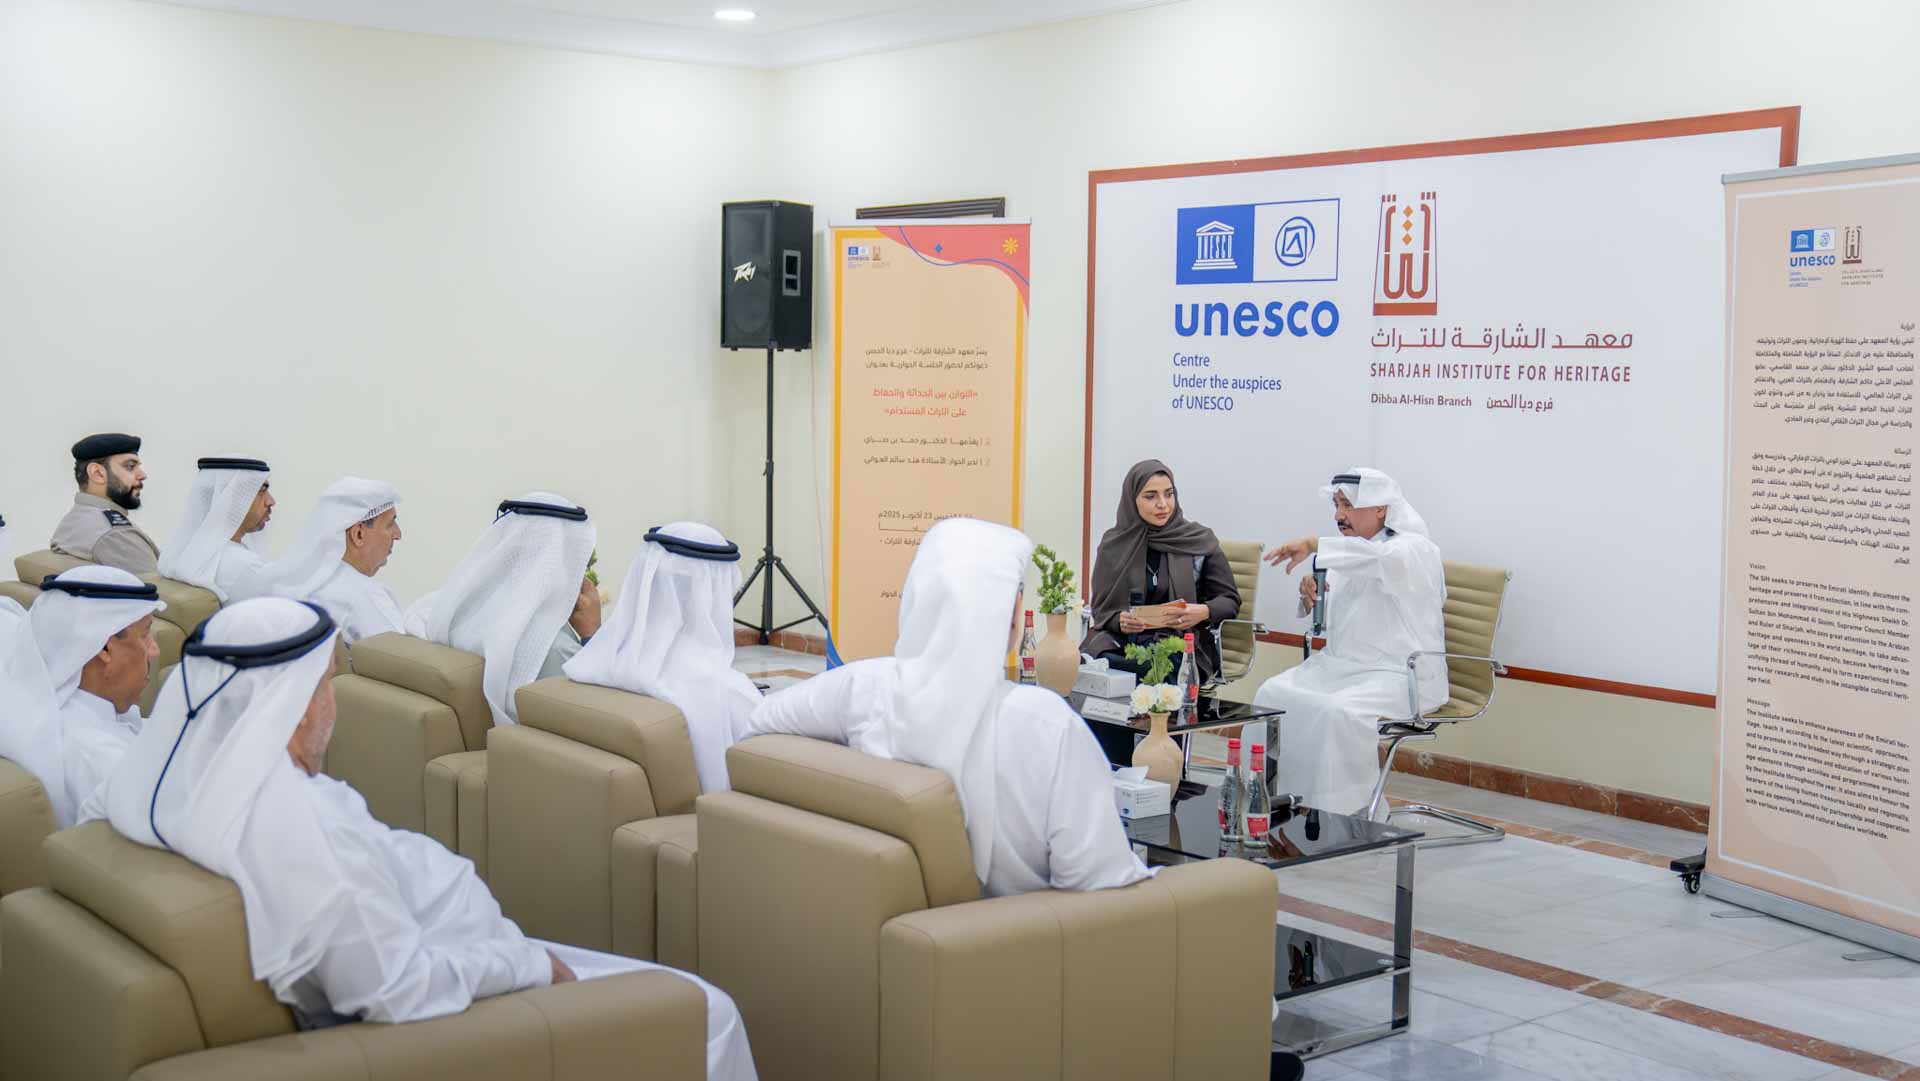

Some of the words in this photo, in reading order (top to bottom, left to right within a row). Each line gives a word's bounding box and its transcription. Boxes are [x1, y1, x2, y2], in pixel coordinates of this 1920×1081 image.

[1790, 255, 1836, 268] unesco
[1175, 301, 1339, 337] unesco
[1371, 328, 1446, 353] للتراث
[1451, 323, 1545, 355] الشارقة
[1552, 333, 1632, 349] معهد
[1172, 352, 1210, 367] Centre
[1371, 363, 1430, 378] SHARJAH
[1437, 364, 1510, 380] INSTITUTE
[1518, 365, 1546, 381] FOR
[1554, 365, 1630, 382] HERITAGE
[1173, 373, 1207, 388] Under
[1210, 374, 1229, 389] the
[1232, 376, 1282, 394] auspices
[1172, 394, 1184, 408] of
[1186, 395, 1233, 411] UNESCO
[1371, 393, 1397, 404] Dibba
[1399, 394, 1434, 405] Al-Hisn
[1438, 395, 1471, 406] Branch
[1487, 394, 1517, 409] الحصن
[1519, 395, 1533, 411] دبا
[1536, 397, 1553, 412] فرع
[951, 408, 967, 418] على
